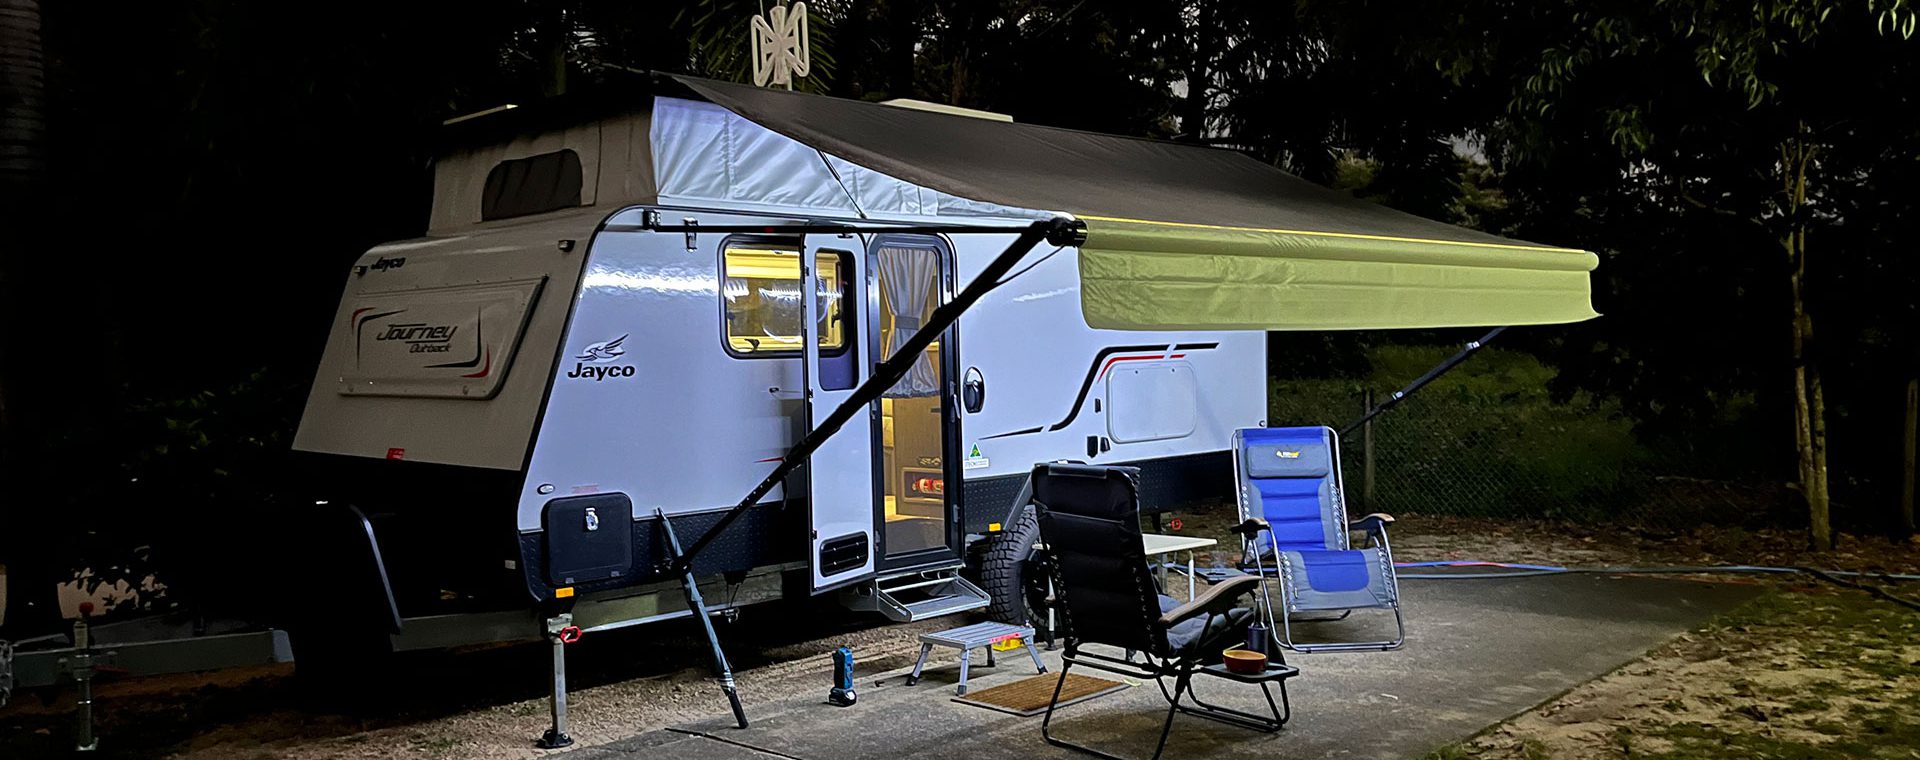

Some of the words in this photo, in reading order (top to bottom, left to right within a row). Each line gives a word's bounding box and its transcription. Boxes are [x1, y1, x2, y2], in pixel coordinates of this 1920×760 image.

[371, 256, 406, 272] Jayco
[376, 324, 458, 343] Journey
[409, 343, 451, 353] Outback
[567, 362, 635, 381] Jayco
